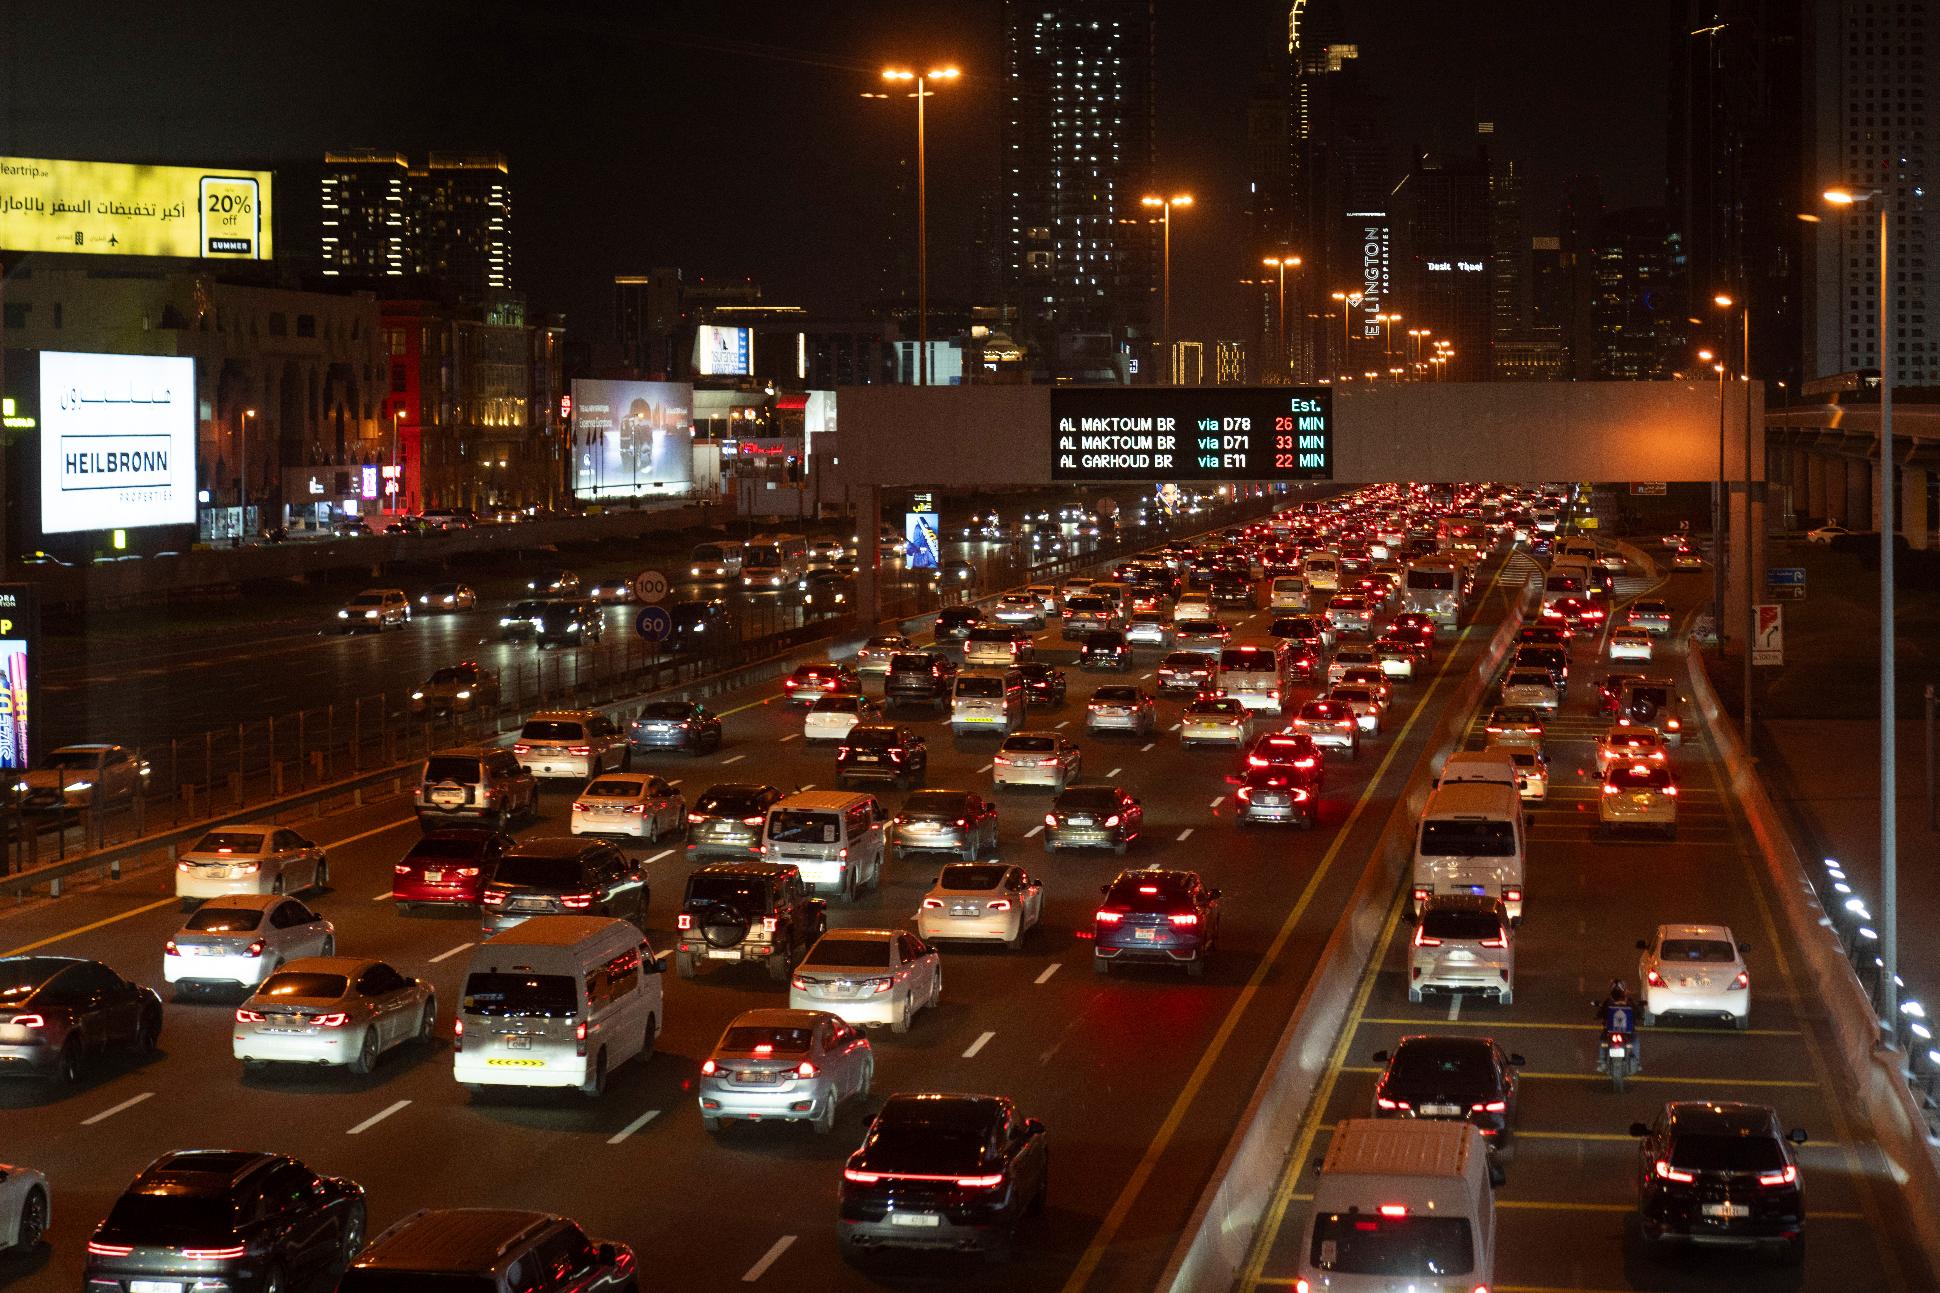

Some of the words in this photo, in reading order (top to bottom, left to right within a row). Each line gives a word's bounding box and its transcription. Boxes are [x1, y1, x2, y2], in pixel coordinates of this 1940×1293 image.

[49, 199, 91, 216] السفر
[97, 200, 156, 220] تخفيضات
[208, 193, 251, 214] 20%
[160, 201, 185, 221] أكبر
[222, 214, 238, 226] off
[212, 241, 248, 250] SUMMER
[1364, 227, 1380, 336] ELLINGTON
[1292, 399, 1320, 412] Est.
[1060, 418, 1076, 431] AL
[1082, 418, 1152, 431] MAKTOUM
[1157, 418, 1175, 431] BR
[1198, 418, 1218, 430] via
[1224, 418, 1250, 430] D78
[1276, 417, 1292, 430] 26
[1299, 417, 1324, 430] MIN
[1060, 436, 1076, 449] AL
[1082, 436, 1152, 449] MAKTOUM
[1158, 436, 1175, 449] BR
[1198, 437, 1218, 449] via
[1224, 436, 1248, 449] D71
[1276, 436, 1292, 449] 33
[1300, 436, 1324, 448] MIN
[66, 451, 168, 474] HEILBRONN
[1061, 455, 1076, 467] AL
[1082, 455, 1149, 467] GARHOUD
[1155, 455, 1173, 467] BR
[1198, 455, 1218, 467] via
[1224, 454, 1245, 467] E11
[1276, 454, 1293, 467] 22
[1300, 454, 1324, 467] MIN
[640, 580, 664, 593] 100
[642, 617, 663, 631] 60
